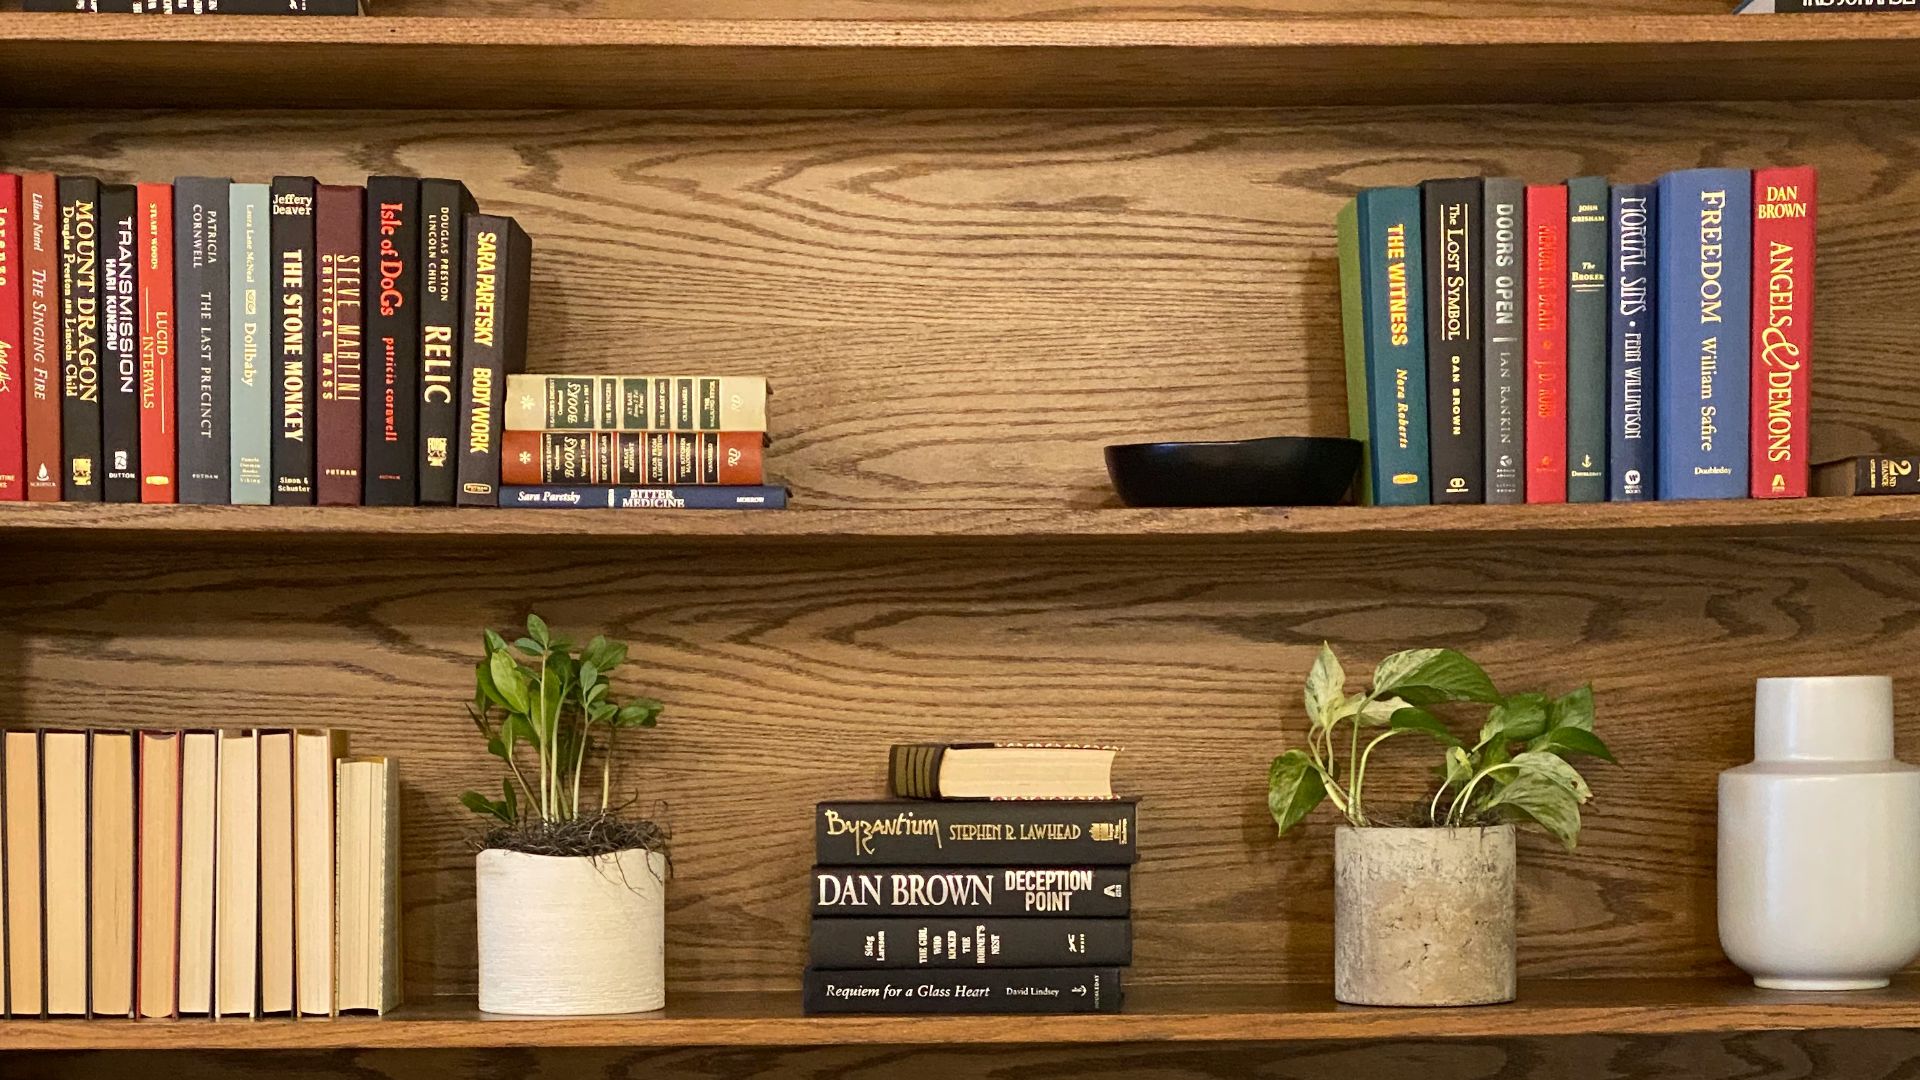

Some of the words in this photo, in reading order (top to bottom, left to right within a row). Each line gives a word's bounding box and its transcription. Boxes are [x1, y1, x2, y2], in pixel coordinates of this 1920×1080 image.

[32, 193, 42, 221] Lilian
[272, 194, 312, 206] Jeffery
[272, 205, 312, 216] Deaver
[1578, 204, 1598, 213] JOHN
[1758, 203, 1807, 219] BROWN
[1767, 186, 1797, 201] DAN
[62, 206, 75, 250] Douglas
[150, 202, 158, 235] STUART
[246, 204, 254, 228] Laura
[380, 203, 403, 236] Isle
[440, 206, 449, 254] DOUGLAS
[1449, 204, 1460, 225] The
[1496, 203, 1514, 267] DOORS
[1620, 197, 1647, 272] MORTAL
[76, 200, 96, 293] MOUNT
[193, 203, 203, 268] CORNWELL
[208, 210, 217, 264] PATRICIA
[246, 230, 254, 249] Lane
[380, 239, 399, 257] of
[428, 214, 437, 258] LINCOLN
[477, 231, 497, 272] SARA
[1387, 223, 1405, 259] THE
[1447, 228, 1463, 272] LOST
[1538, 225, 1556, 272] MEMORY
[63, 253, 76, 295] Preston
[106, 258, 117, 290] HARI
[283, 249, 302, 288] THE
[1700, 189, 1727, 324] FREEDOM
[32, 270, 46, 297] THE
[322, 254, 333, 338] CRITICAL
[337, 254, 361, 307] STEVE
[428, 262, 437, 293] CHILD
[440, 258, 449, 301] PRESTON
[1538, 278, 1556, 289] IN
[1620, 276, 1647, 316] SINS
[1769, 240, 1794, 327] ANGELS
[119, 216, 133, 392] TRANSMISSION
[201, 292, 212, 319] THE
[474, 274, 496, 347] PARETSKY
[1388, 262, 1409, 346] WITNESS
[1447, 276, 1464, 341] SYMBOL
[1496, 276, 1514, 325] OPEN
[1538, 294, 1556, 331] DEATH
[33, 301, 47, 363] SINGING
[65, 318, 77, 360] Lincoln
[106, 295, 117, 350] KUNZRU
[156, 311, 168, 356] LUCID
[283, 293, 303, 355] STONE
[77, 297, 97, 403] DRAGON
[201, 327, 212, 360] LAST
[241, 322, 257, 387] Dollbaby
[337, 324, 361, 400] MARTINI
[382, 337, 397, 385] patricia
[1625, 332, 1642, 362] PENN
[1761, 327, 1800, 371] &
[34, 367, 48, 400] FIRE
[66, 365, 77, 397] Child
[143, 336, 154, 409] INTERVALS
[322, 352, 333, 400] MASS
[424, 325, 451, 404] RELIC
[1396, 368, 1408, 399] Nora
[1452, 355, 1460, 383] DAN
[1500, 352, 1511, 378] IAN
[1701, 336, 1717, 400] William
[201, 367, 212, 438] PRECINCT
[284, 361, 303, 442] MONKEY
[472, 367, 492, 407] BODY
[567, 382, 581, 424] BOOKS
[1625, 366, 1642, 439] WILLIAMSON
[385, 388, 398, 441] cornwell
[470, 406, 491, 454] WORK
[1397, 402, 1409, 449] Roberts
[1452, 388, 1461, 435] BROWN
[1500, 386, 1511, 444] RANKIN
[1701, 406, 1718, 452] Safire
[1768, 371, 1791, 462] DEMONS
[564, 436, 577, 478] BOOKS
[602, 454, 607, 463] OF
[728, 448, 741, 467] RD
[1695, 466, 1732, 475] Doubleday
[278, 485, 311, 493] Schuster
[517, 491, 541, 501] Sara
[542, 491, 581, 504] Paretsky
[622, 498, 685, 508] MEDICINE
[630, 489, 674, 499] BITTER
[824, 809, 943, 856] Byzantium
[949, 824, 1002, 841] STEPHEN
[1005, 824, 1017, 840] R.
[1020, 823, 1081, 840] LAWHEAD
[817, 874, 882, 906] DAN
[891, 874, 994, 906] BROWN
[1005, 870, 1093, 891] DECEPTION
[1025, 891, 1073, 911] POINT
[864, 935, 875, 957] Stieg
[877, 930, 885, 961] Larsson
[919, 927, 928, 946] GIRL
[919, 947, 928, 963] THE
[933, 935, 942, 955] WHO
[962, 937, 971, 954] THE
[990, 934, 1000, 955] NEST
[825, 984, 880, 1000] Requiem
[883, 984, 902, 1000] for
[905, 988, 913, 997] a
[917, 985, 951, 997] Glass
[954, 985, 990, 997] Heart
[1006, 987, 1029, 996] David
[1031, 987, 1060, 997] Lindsey
